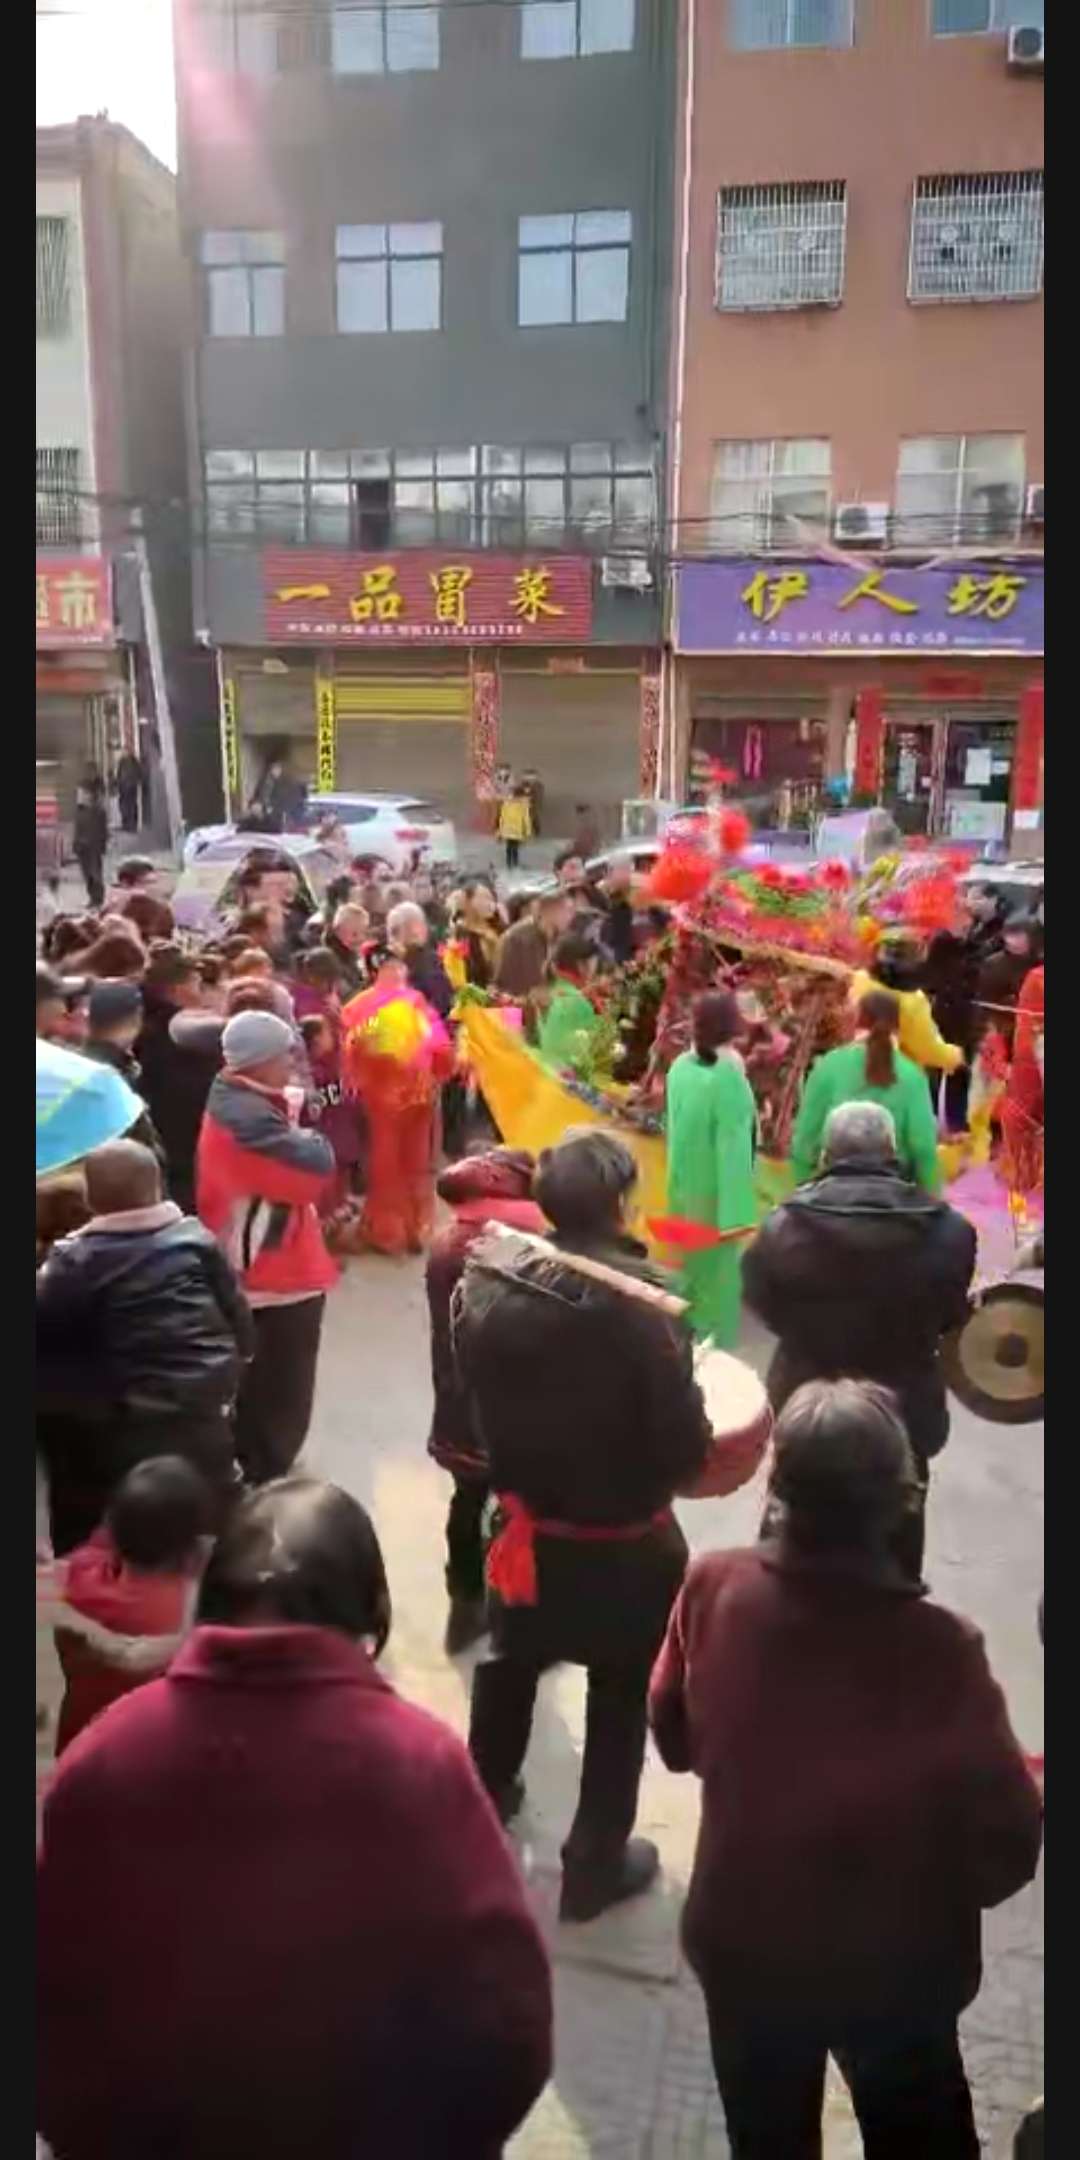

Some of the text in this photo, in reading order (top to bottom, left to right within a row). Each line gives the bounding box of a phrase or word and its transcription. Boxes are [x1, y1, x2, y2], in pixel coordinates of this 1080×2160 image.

[276, 565, 567, 626] 一品冒菜
[741, 570, 1027, 623] 伊人坊
